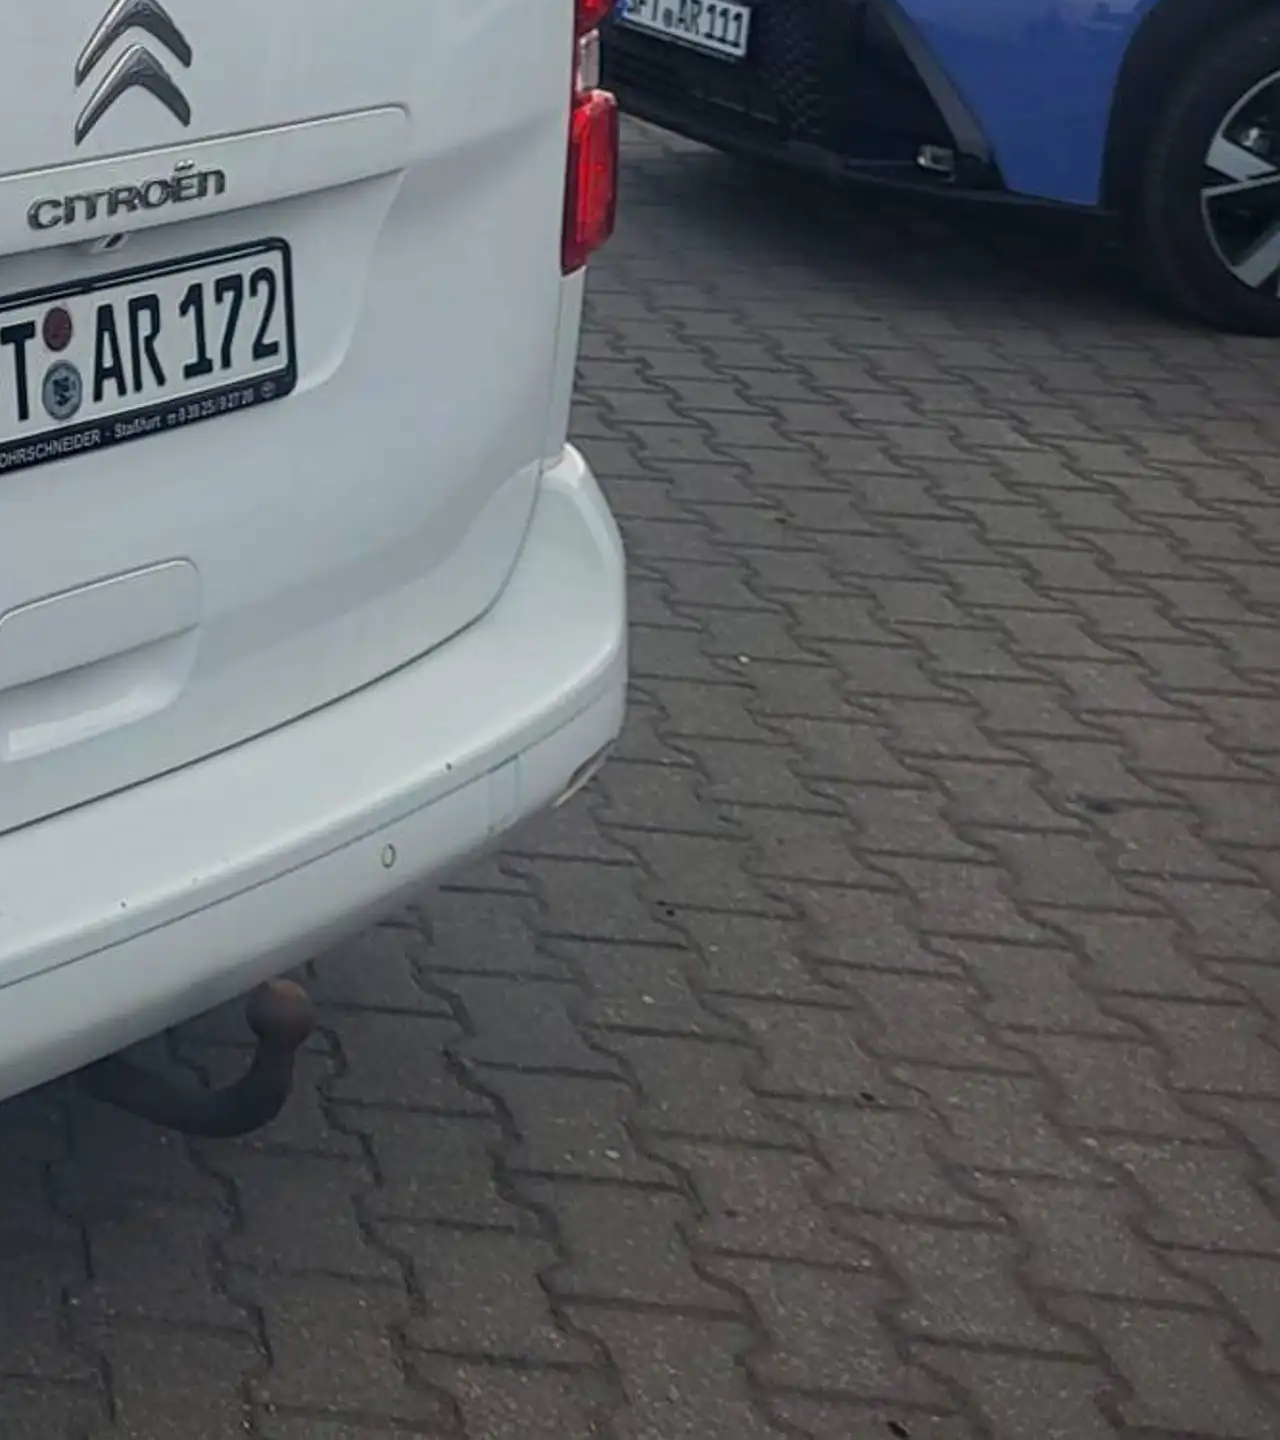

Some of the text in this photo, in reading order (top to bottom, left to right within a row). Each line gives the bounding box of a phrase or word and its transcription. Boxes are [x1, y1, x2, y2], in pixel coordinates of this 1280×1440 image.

[703, 3, 744, 48] 111
[93, 294, 166, 402] AR
[179, 267, 280, 379] 172
